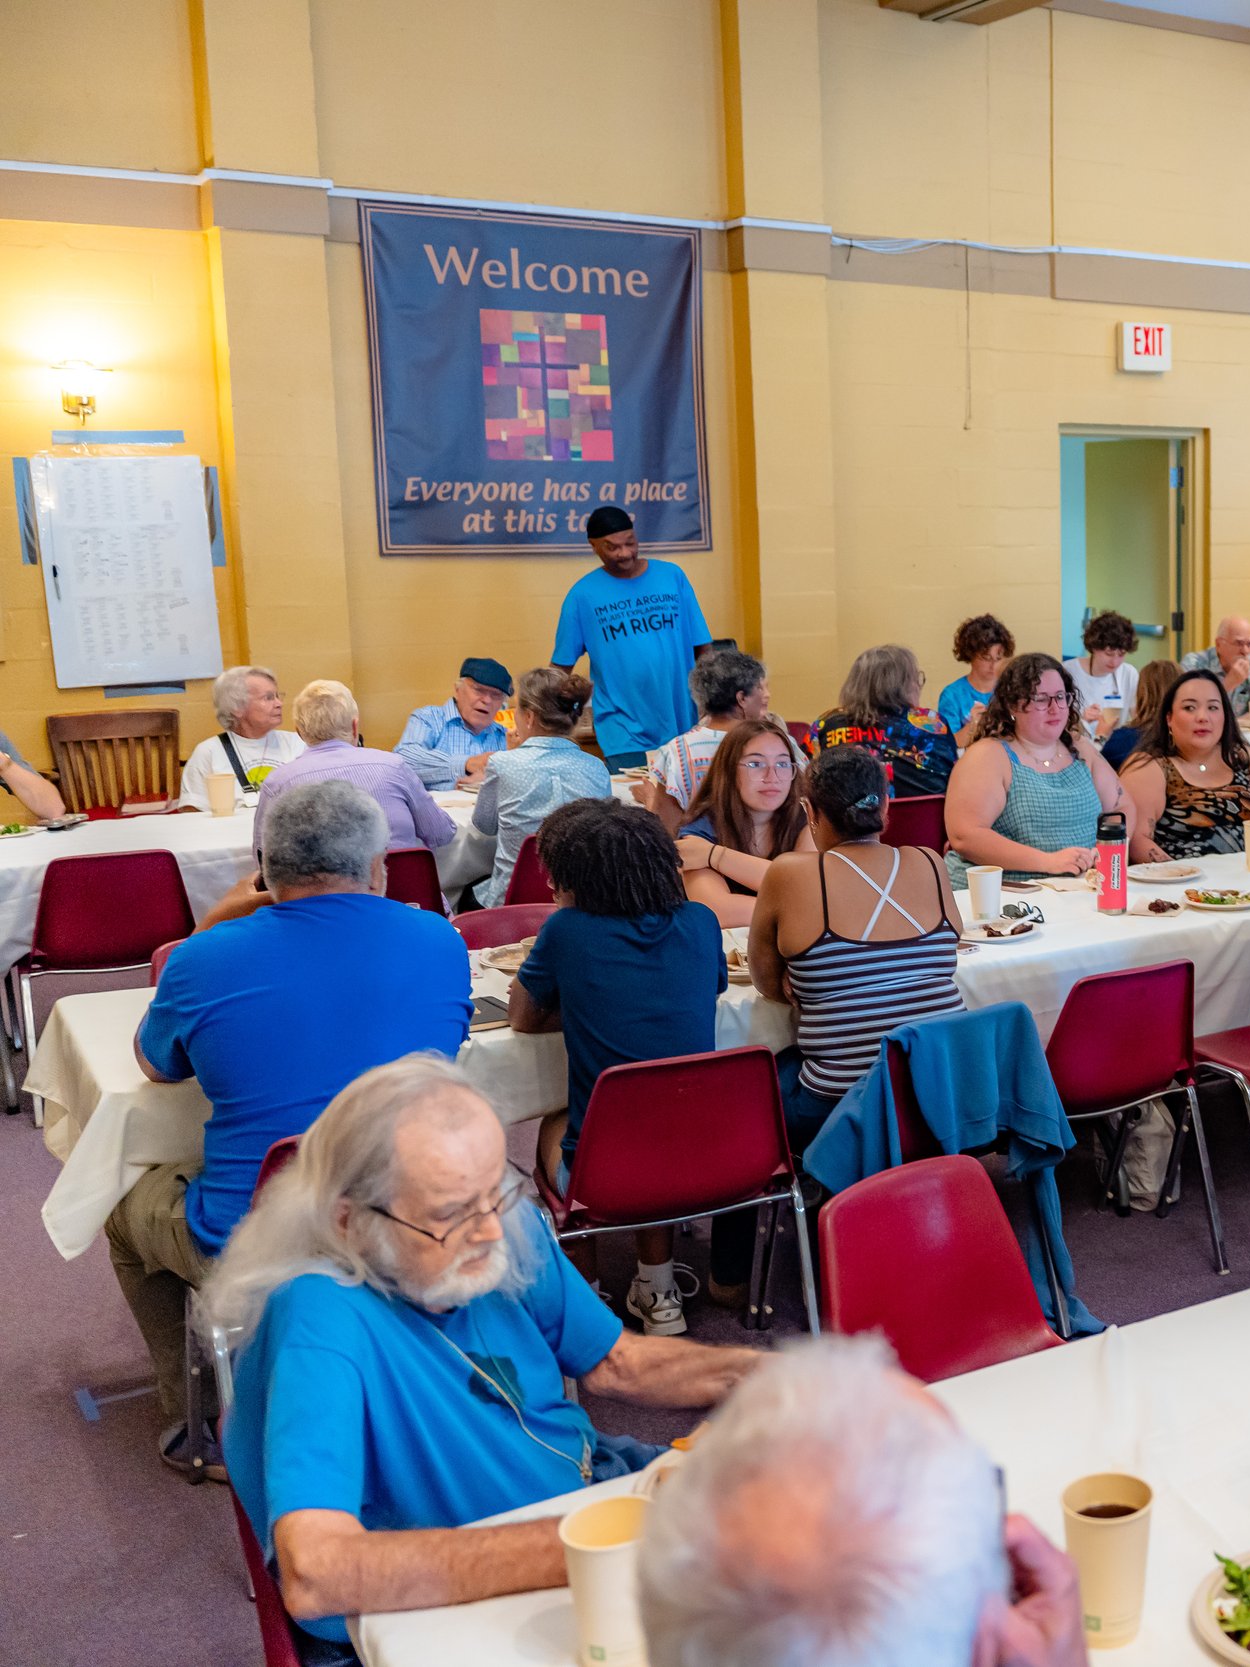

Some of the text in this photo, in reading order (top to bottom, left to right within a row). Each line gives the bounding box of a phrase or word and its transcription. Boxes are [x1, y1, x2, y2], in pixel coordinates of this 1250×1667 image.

[423, 243, 650, 298] Welcome
[1133, 325, 1164, 356] EXIT
[404, 476, 688, 505] Everyone has a place
[462, 510, 495, 533] at
[503, 508, 557, 533] this
[609, 599, 632, 610] NOT
[601, 621, 628, 642] I'M
